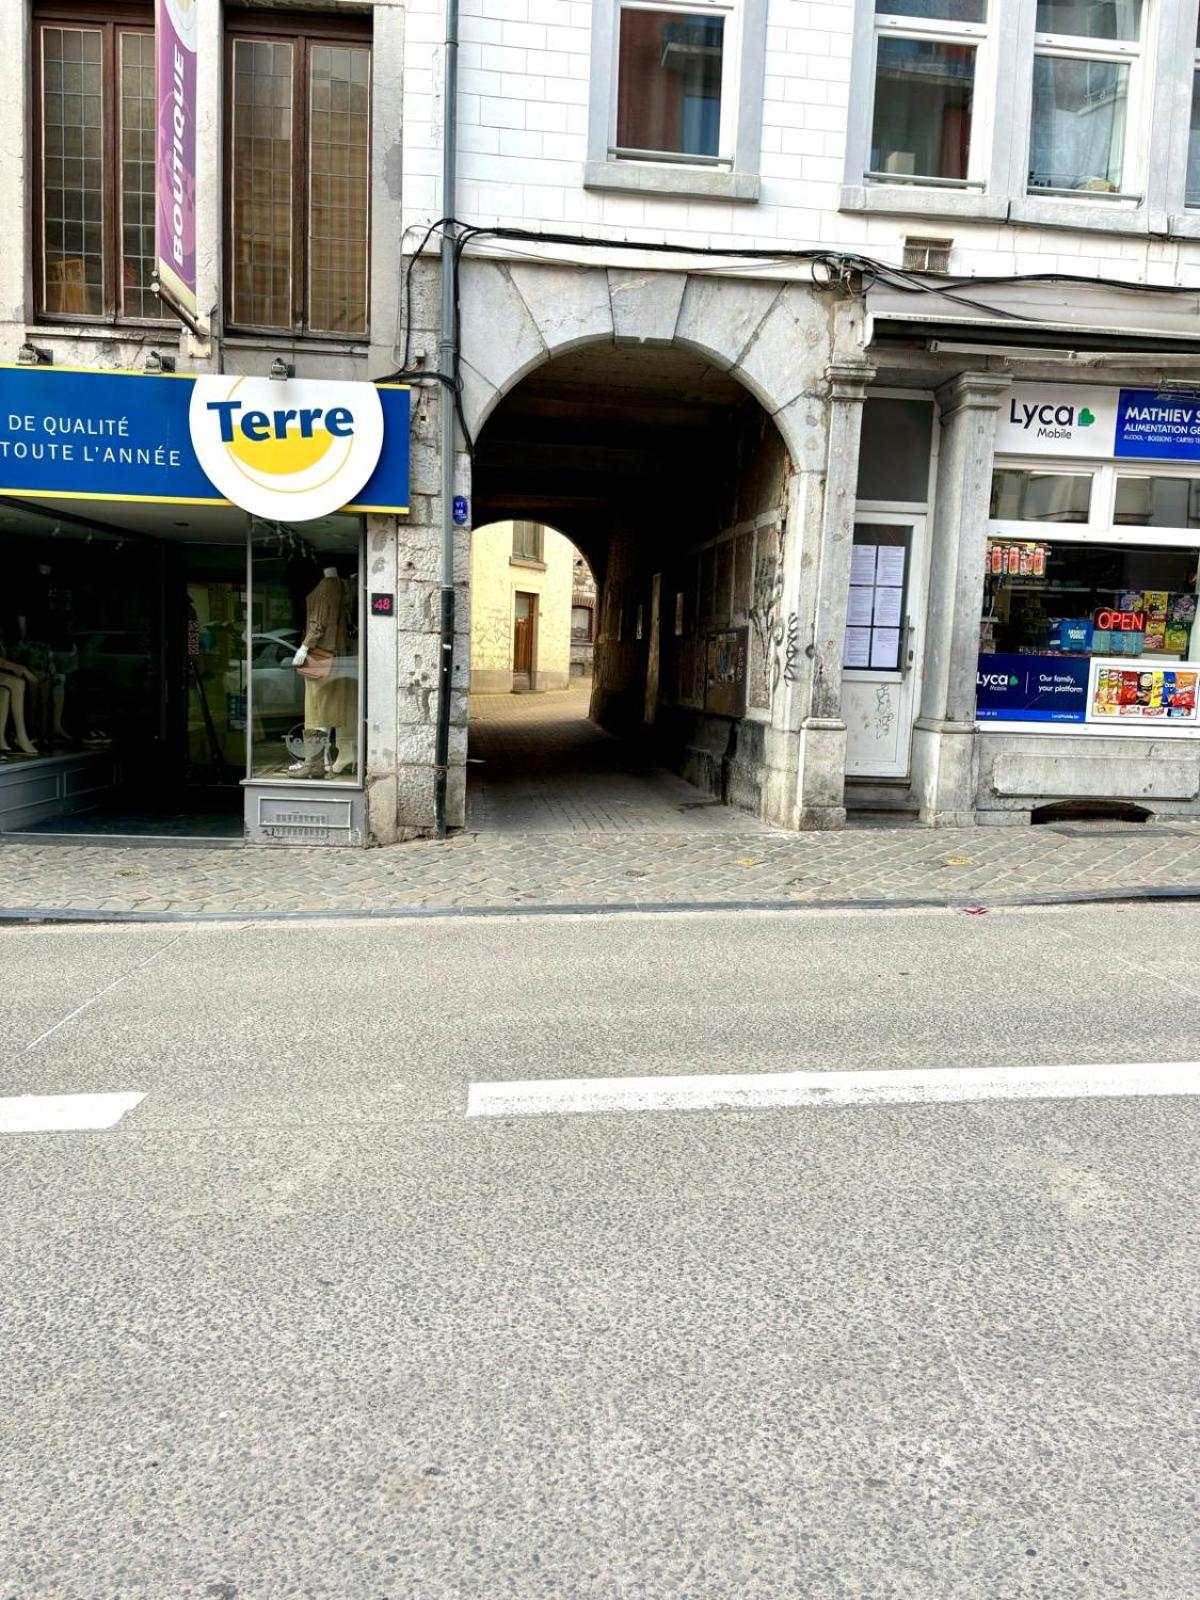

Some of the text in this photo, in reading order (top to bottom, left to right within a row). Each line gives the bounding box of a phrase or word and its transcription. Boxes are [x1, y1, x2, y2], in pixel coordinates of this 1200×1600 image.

[172, 45, 184, 267] BOUTIQUE
[206, 401, 355, 442] Terre
[1010, 398, 1074, 429] Lyca
[1124, 406, 1193, 423] MATHIEV
[8, 414, 130, 437] DE QUALITÉ
[1037, 427, 1072, 440] Mobile
[1124, 423, 1188, 434] ALIMENTATION
[0, 441, 181, 466] TOUTE L'ANNÉE
[373, 597, 391, 610] 48
[1098, 611, 1144, 630] OPEN
[976, 671, 1009, 687] Lyca
[1039, 674, 1053, 682] Our
[1038, 685, 1084, 694] your platform
